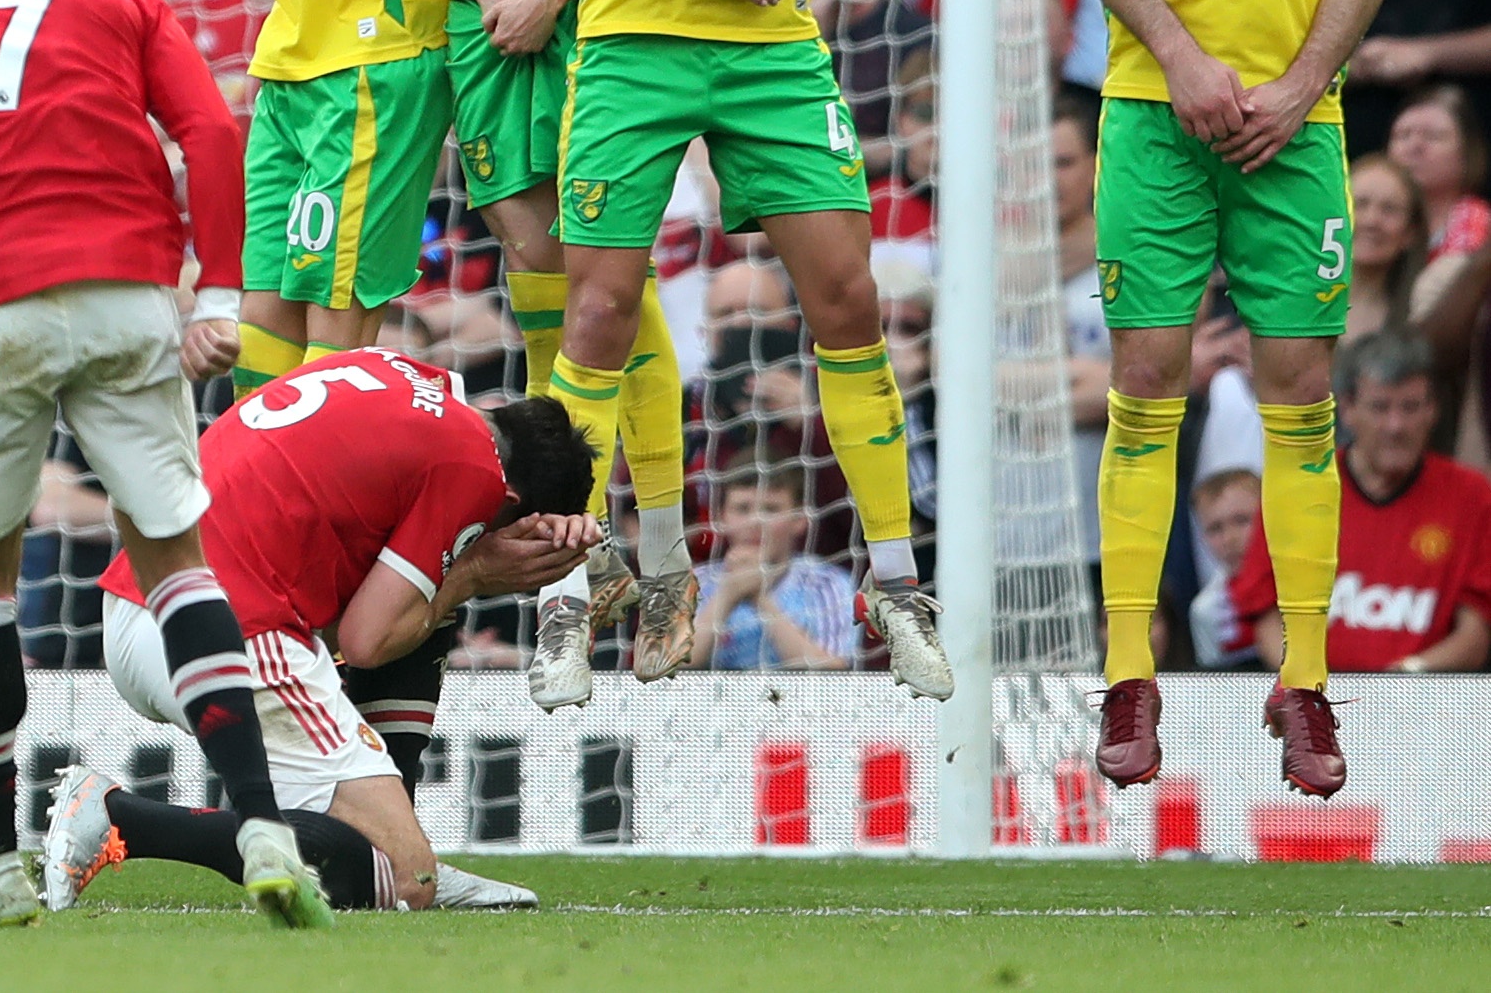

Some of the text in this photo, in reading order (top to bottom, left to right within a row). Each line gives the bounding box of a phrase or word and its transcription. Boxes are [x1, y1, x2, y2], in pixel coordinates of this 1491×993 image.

[825, 101, 856, 160] 4
[1316, 217, 1346, 281] 5
[238, 364, 388, 430] 5
